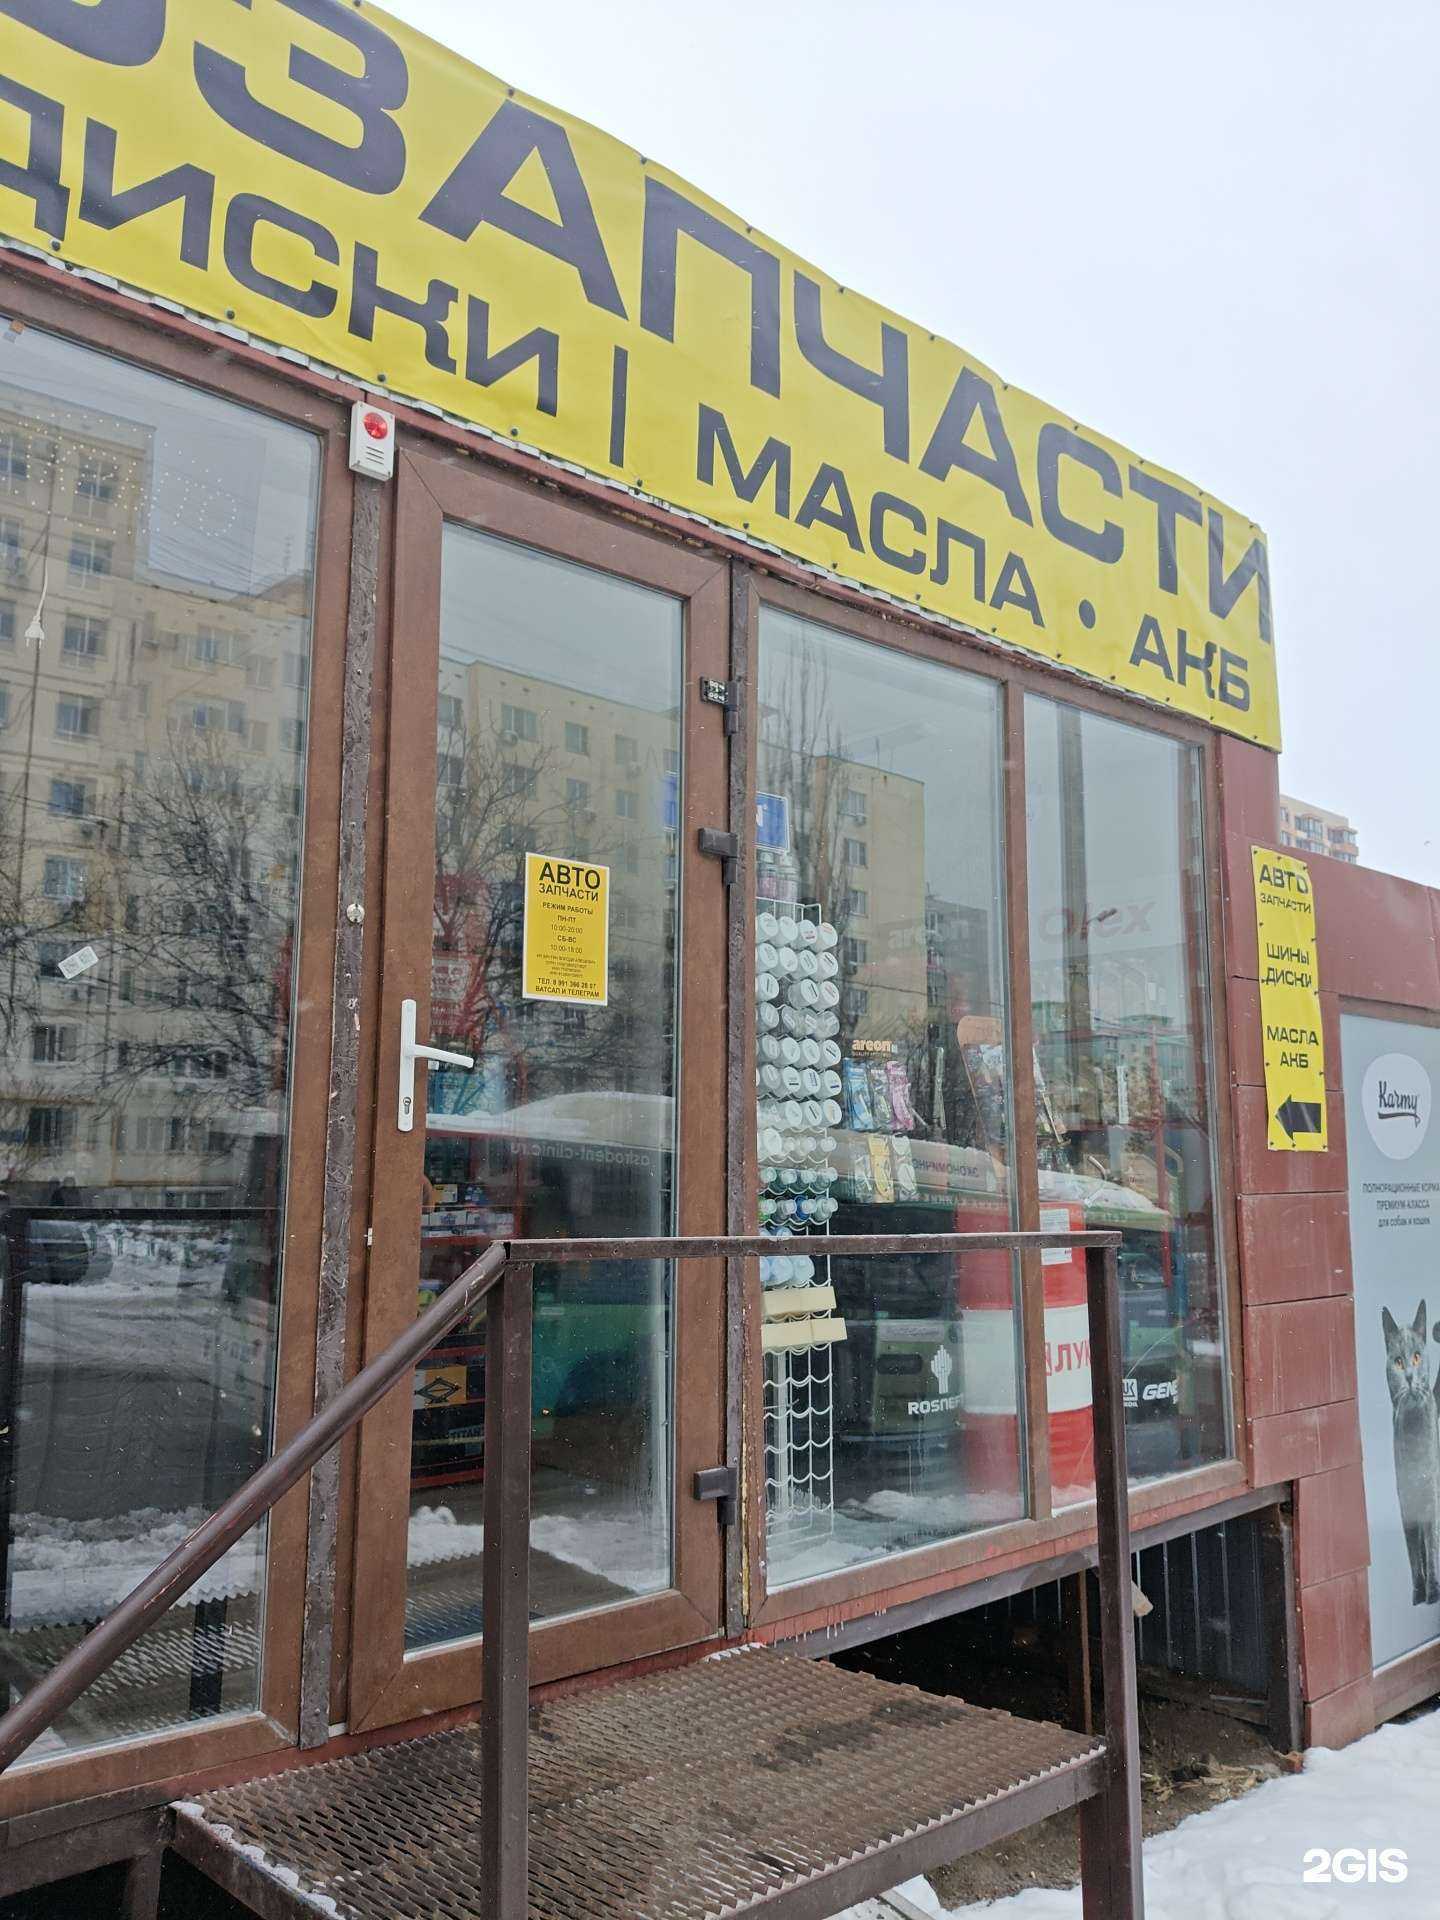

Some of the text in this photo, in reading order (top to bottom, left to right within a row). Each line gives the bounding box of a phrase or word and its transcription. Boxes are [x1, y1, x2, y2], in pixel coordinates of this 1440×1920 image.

[697, 402, 1045, 629] МАСЛА
[1129, 614, 1250, 712] АКБ
[539, 862, 600, 889] АВТО
[1259, 864, 1309, 894] АВТО
[539, 883, 598, 901] ЗАПЧАСТИ
[543, 902, 594, 915] РЕЖИМ РАБОТЫ
[1260, 893, 1311, 914] ЗАПЧАСТИ
[557, 915, 577, 923] ПН-ПТ
[557, 935, 577, 944] СБ-ВС
[1266, 942, 1309, 965] ШИНЫ
[1266, 967, 1312, 988] ДИСКИ
[568, 988, 600, 998] ТЕЛЕГРАМ
[852, 1040, 890, 1051] areon
[1266, 1025, 1319, 1046] МАСЛА
[1280, 1051, 1309, 1069] АКБ
[1378, 1080, 1421, 1122] Karmy
